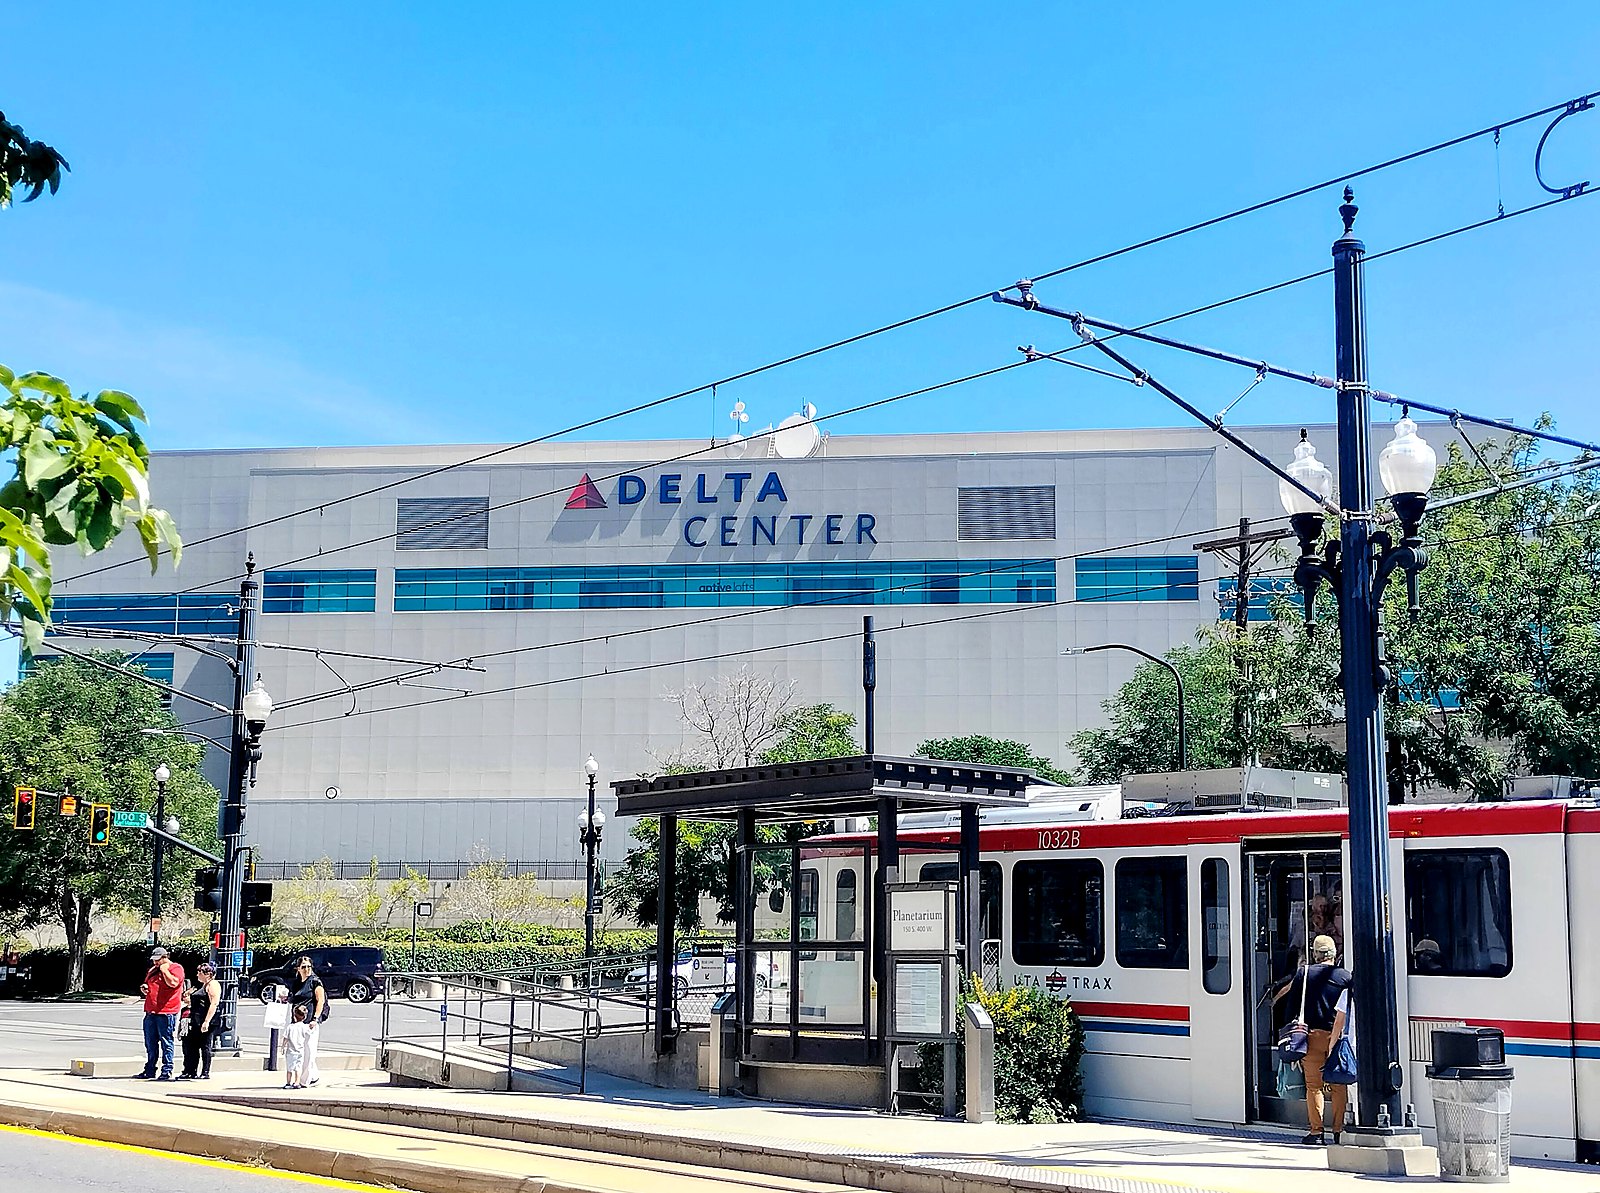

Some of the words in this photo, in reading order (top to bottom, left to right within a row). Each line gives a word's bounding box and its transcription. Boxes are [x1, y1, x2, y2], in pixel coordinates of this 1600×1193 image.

[618, 471, 788, 504] DELTA
[684, 514, 878, 547] CENTER
[117, 812, 135, 821] 100
[139, 813, 146, 821] S
[1038, 830, 1080, 849] 1032B
[893, 909, 943, 921] Planetarium
[1013, 974, 1040, 987] UTA
[1072, 976, 1112, 990] TRAX
